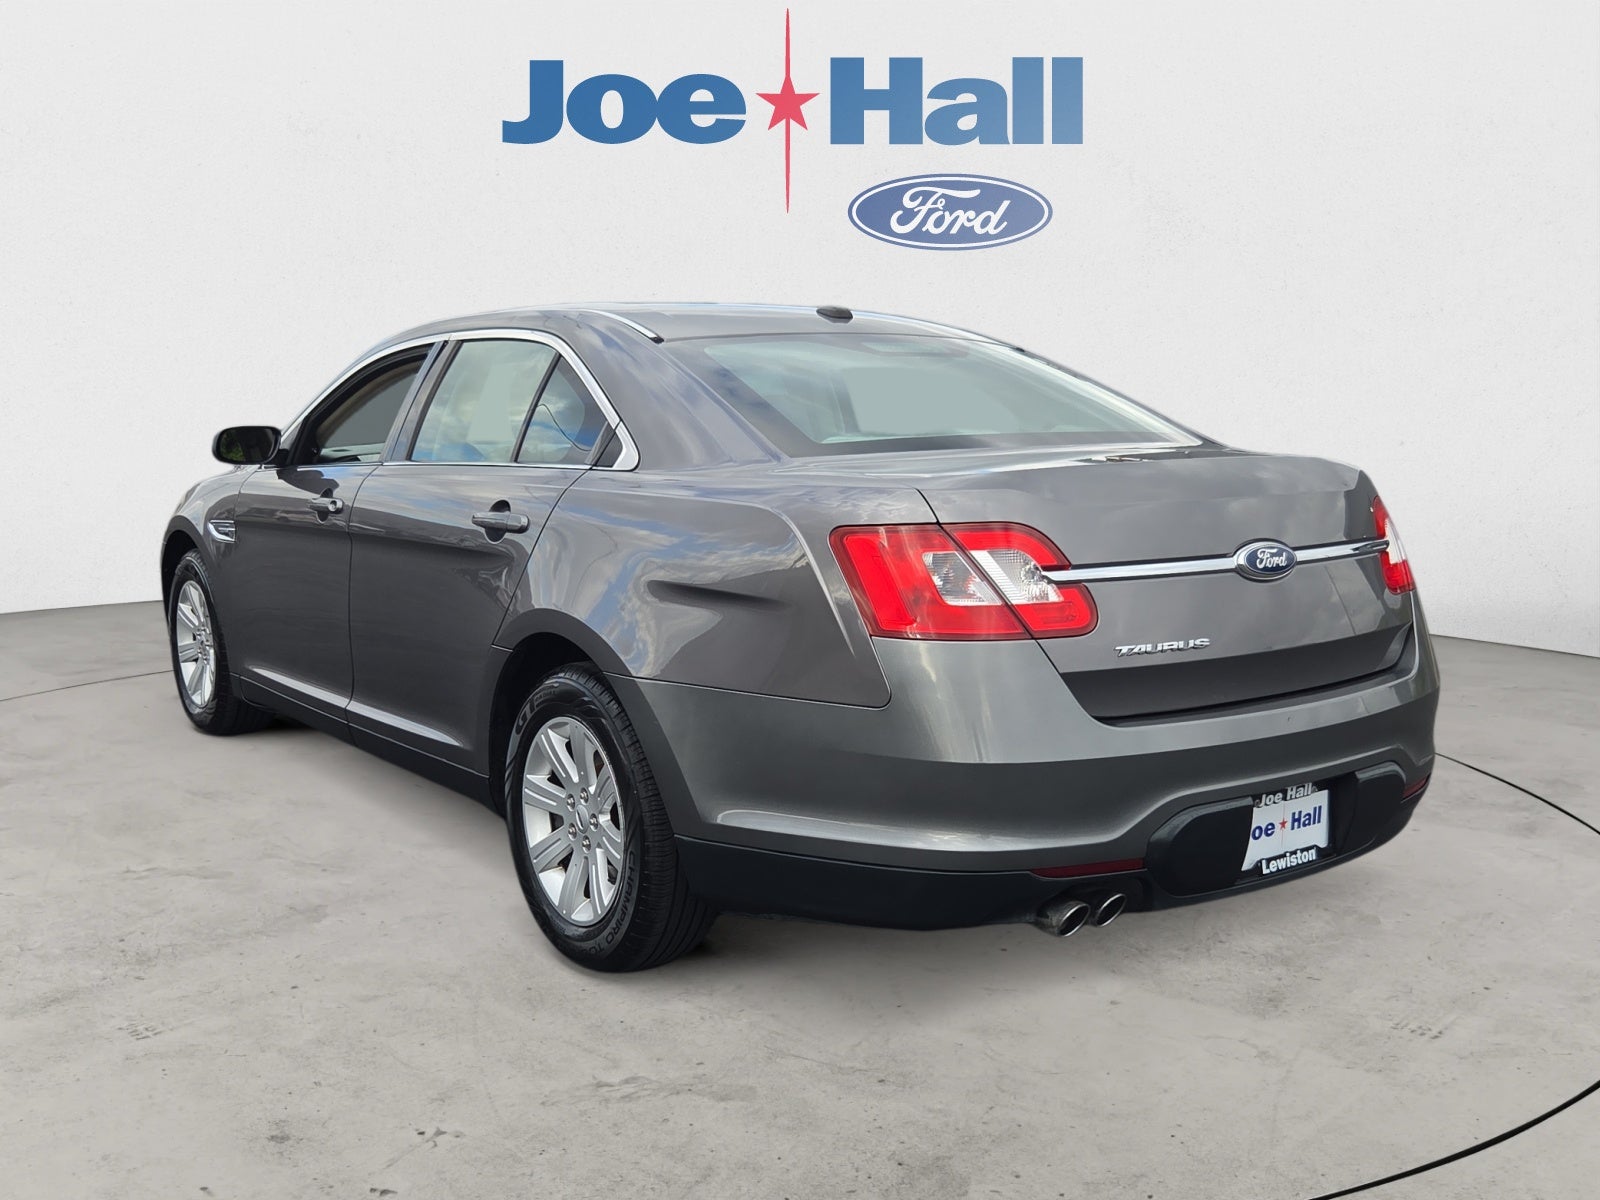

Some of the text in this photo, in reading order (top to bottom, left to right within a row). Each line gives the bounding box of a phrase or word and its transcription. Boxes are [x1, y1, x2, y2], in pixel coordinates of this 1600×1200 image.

[1257, 549, 1287, 569] Ford
[1115, 638, 1210, 657] TAURUS
[1258, 782, 1312, 808] Joe Hall
[1251, 805, 1322, 841] oe Hall
[1261, 848, 1317, 875] Lewiston
